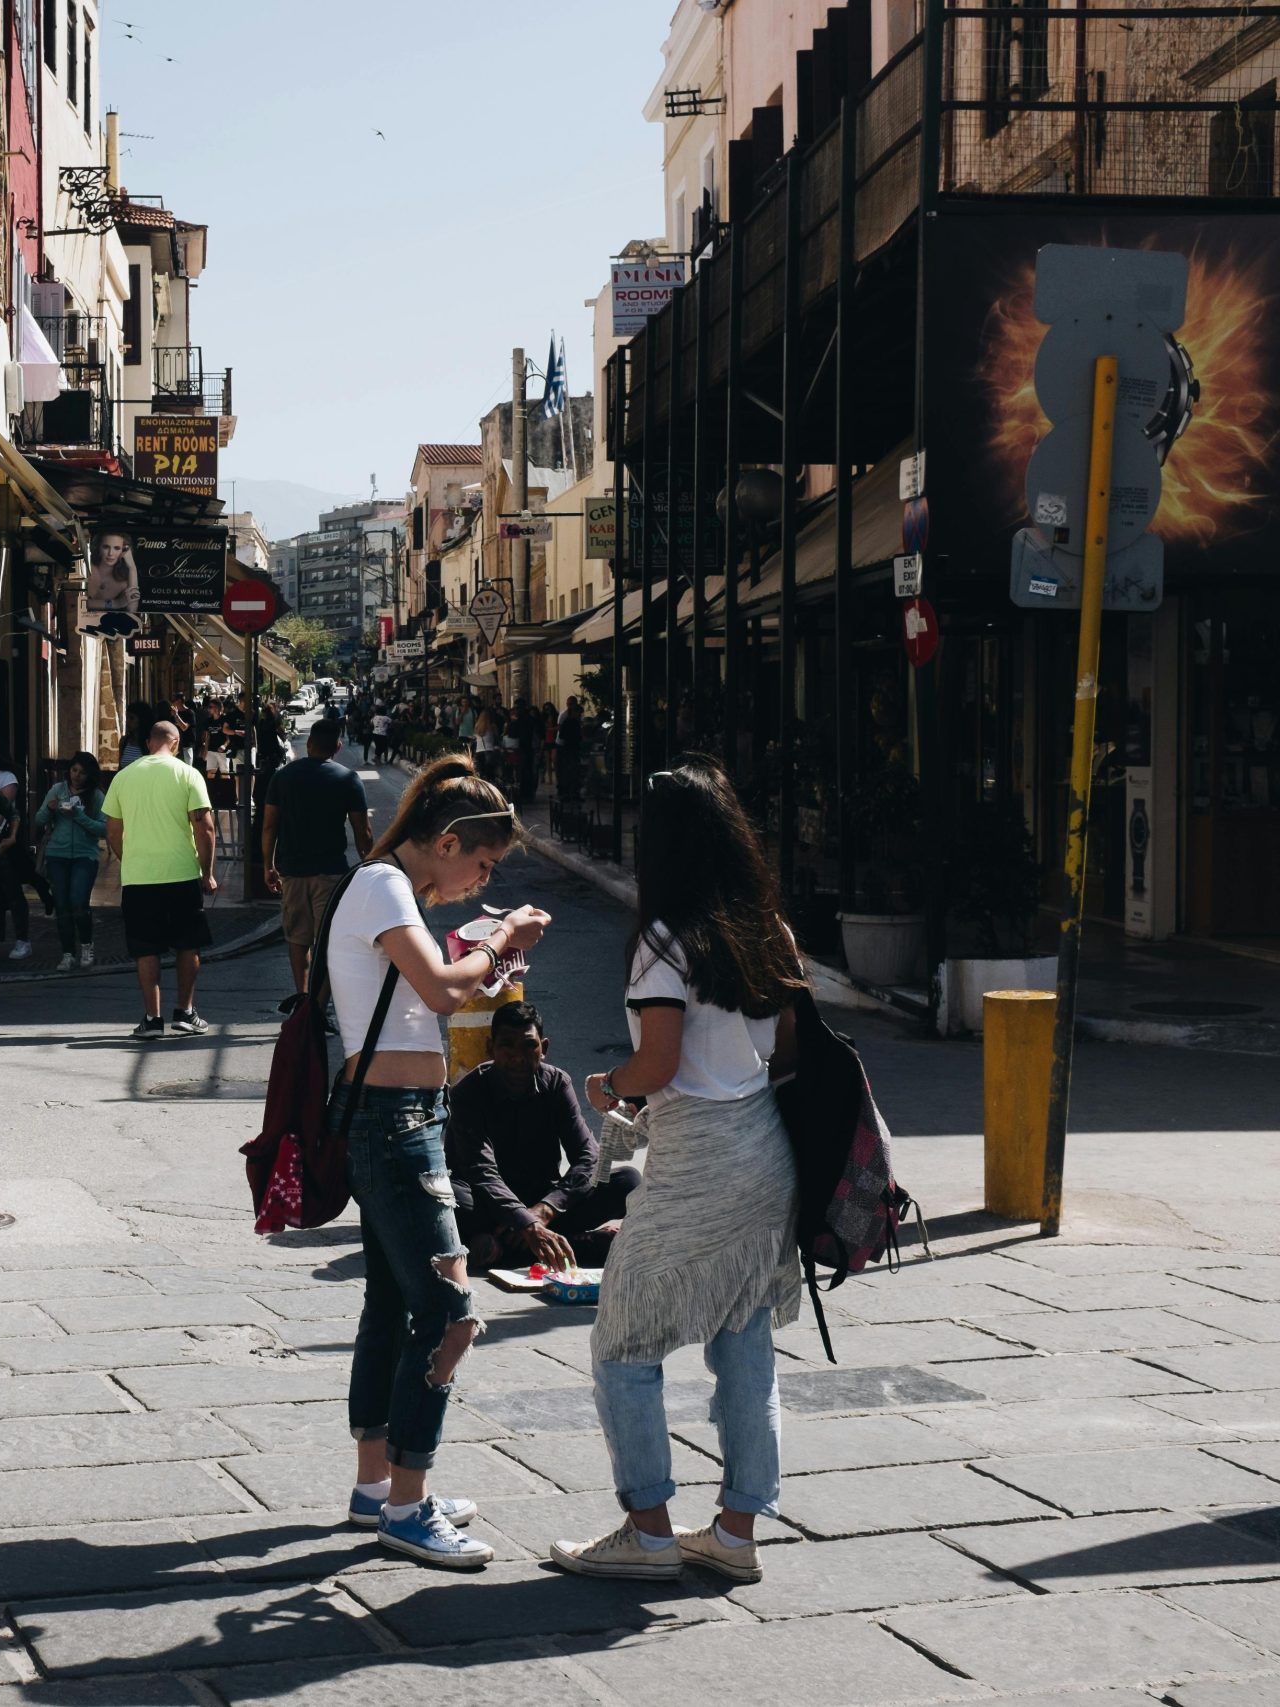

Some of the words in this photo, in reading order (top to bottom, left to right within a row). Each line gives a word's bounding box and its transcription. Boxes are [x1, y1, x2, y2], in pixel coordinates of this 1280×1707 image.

[136, 436, 168, 452] RENT
[174, 436, 216, 452] ROOMS
[153, 454, 197, 475] PIA
[155, 477, 216, 485] CONDITIONED
[136, 537, 167, 549] Panos
[151, 587, 172, 595] GOLD
[134, 639, 160, 649] DIESEL
[494, 949, 525, 979] chill
